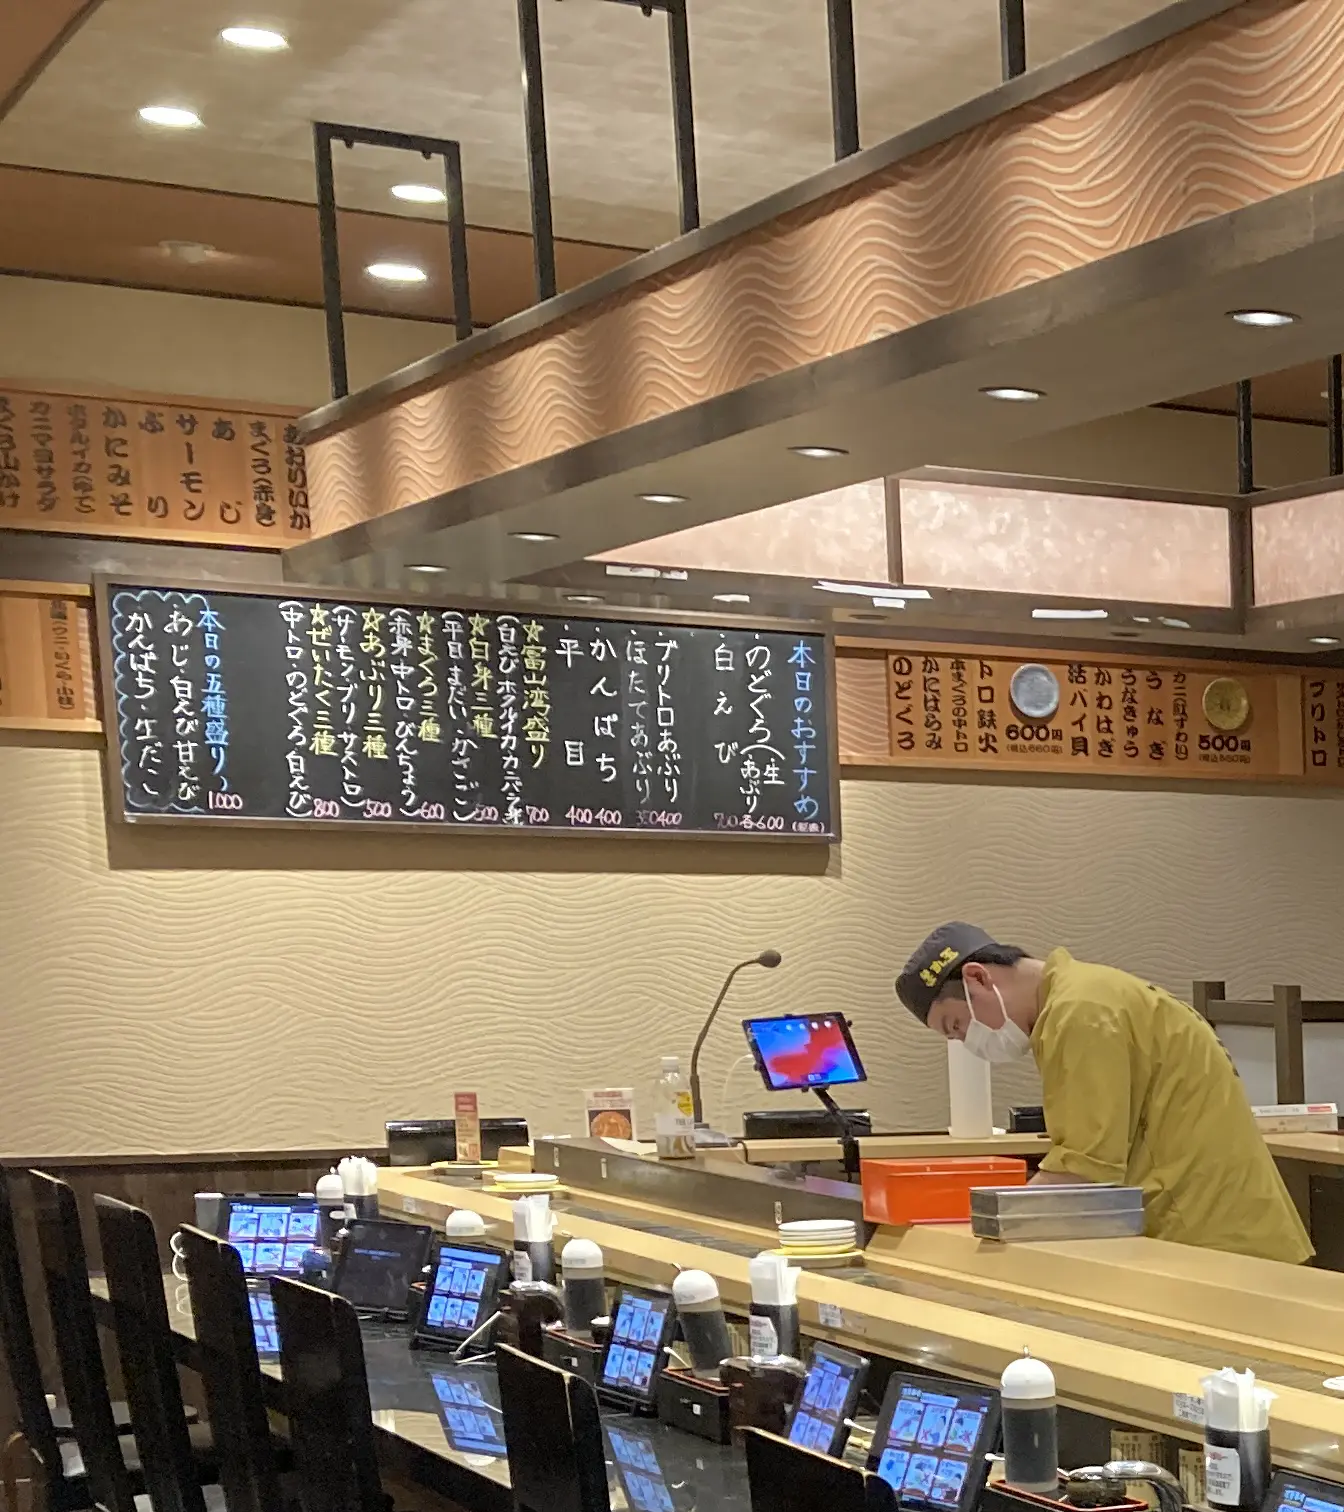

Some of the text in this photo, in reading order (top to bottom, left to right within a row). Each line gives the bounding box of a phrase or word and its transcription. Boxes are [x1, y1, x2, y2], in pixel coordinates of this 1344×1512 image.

[102, 406, 133, 517] かにみそ
[138, 410, 168, 519] ぶり
[176, 414, 204, 520] サーモン
[212, 417, 243, 524] あじ
[555, 638, 584, 766] 平目
[713, 643, 739, 764] 白えび
[787, 640, 819, 820] 本日のおすすめ
[893, 657, 915, 750] のどぐろ
[977, 660, 998, 754] トロ鉄火
[1005, 724, 1063, 741] 600円
[1067, 664, 1089, 757] 活バイ貝
[1094, 667, 1116, 758] かわはぎ
[1146, 671, 1168, 760] うなぎ
[1198, 735, 1251, 752] 500円
[312, 799, 340, 819] 800
[362, 799, 392, 818] 500
[418, 802, 446, 820] 600
[525, 805, 550, 824] 700
[565, 807, 593, 825] 400
[594, 806, 622, 825] 400
[657, 810, 682, 827] 400
